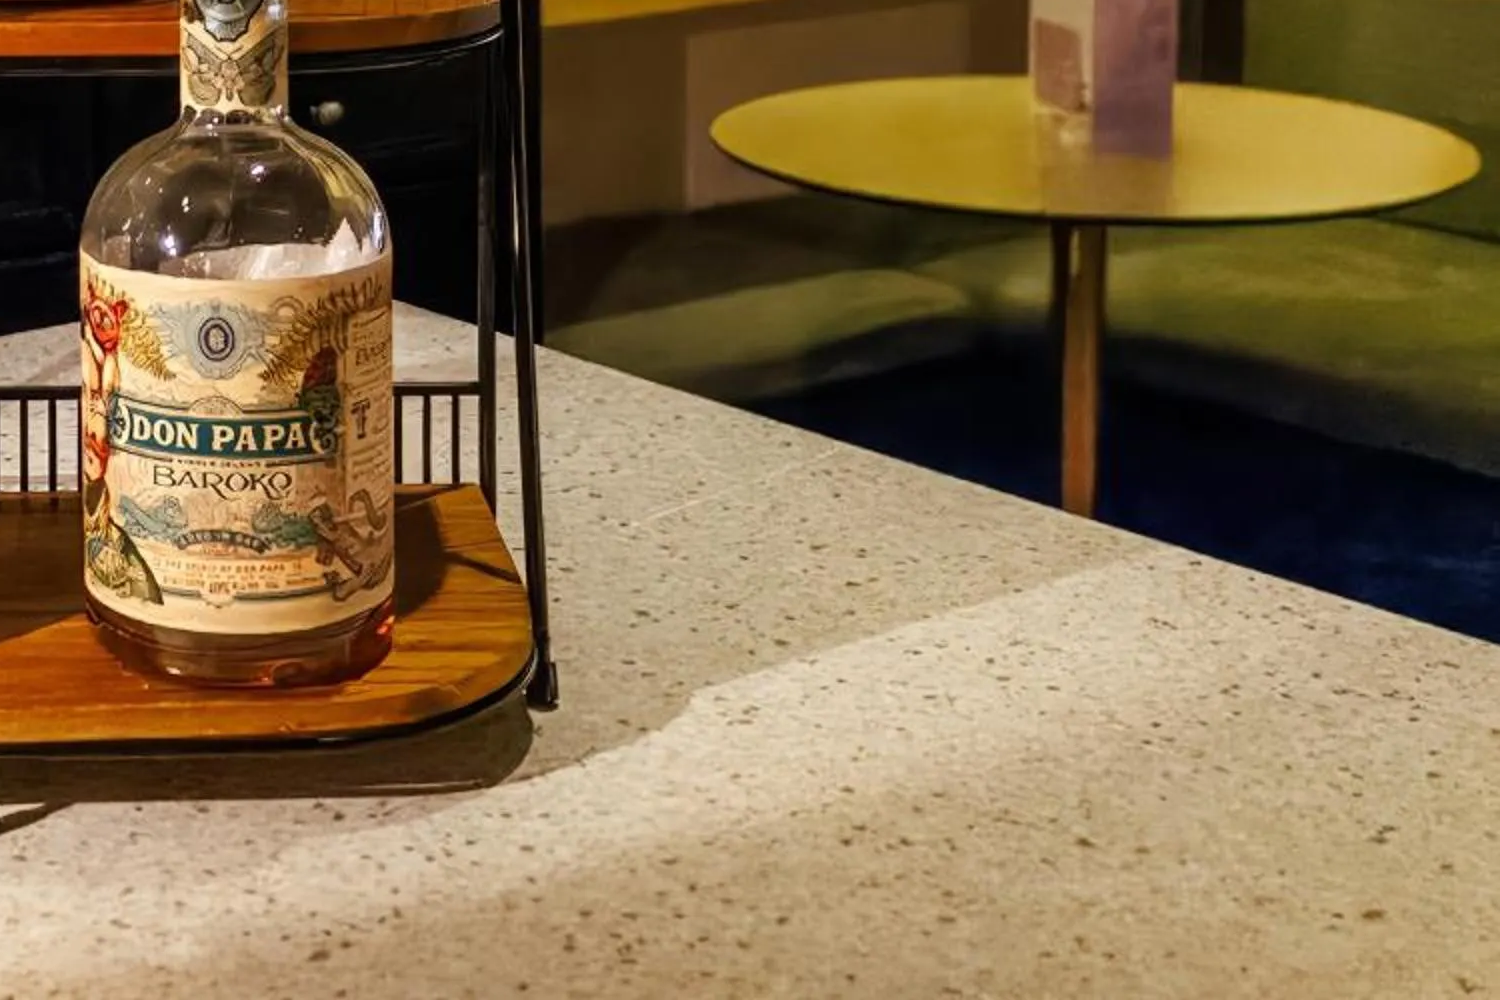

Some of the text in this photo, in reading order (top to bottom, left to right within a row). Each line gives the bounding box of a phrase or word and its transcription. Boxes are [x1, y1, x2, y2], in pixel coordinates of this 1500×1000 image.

[132, 412, 307, 452] DON PAPA
[152, 464, 293, 501] BAROKO
